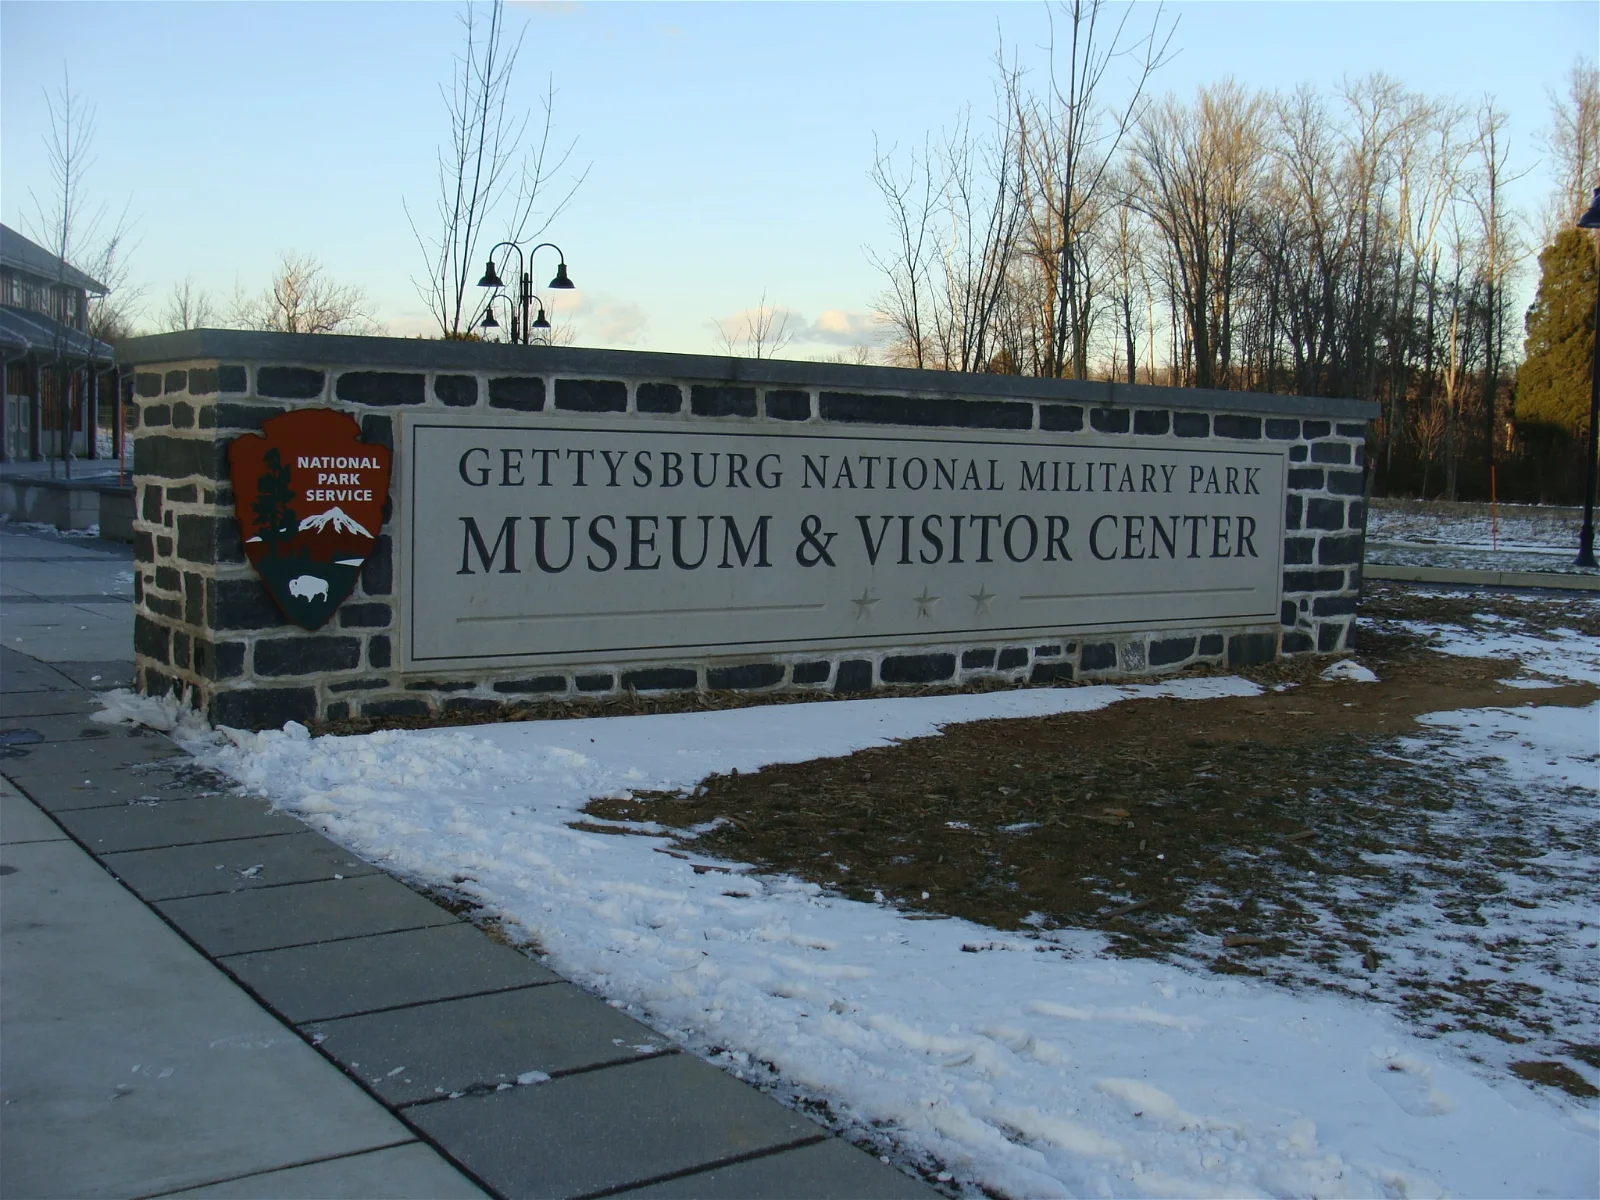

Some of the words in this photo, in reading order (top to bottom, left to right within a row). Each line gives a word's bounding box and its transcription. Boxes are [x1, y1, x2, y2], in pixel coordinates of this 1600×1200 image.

[297, 456, 381, 469] NATIONAL
[458, 447, 784, 489] GETTYSBURG
[801, 454, 1005, 491] NATIONAL
[1018, 460, 1178, 493] MILITARY
[1187, 464, 1261, 496] PARK
[318, 473, 361, 485] PARK
[306, 489, 373, 502] SERVICE
[456, 514, 773, 575] MUSEUM
[795, 514, 839, 568] &
[854, 513, 1074, 566] VISITOR
[1088, 514, 1259, 561] CENTER
